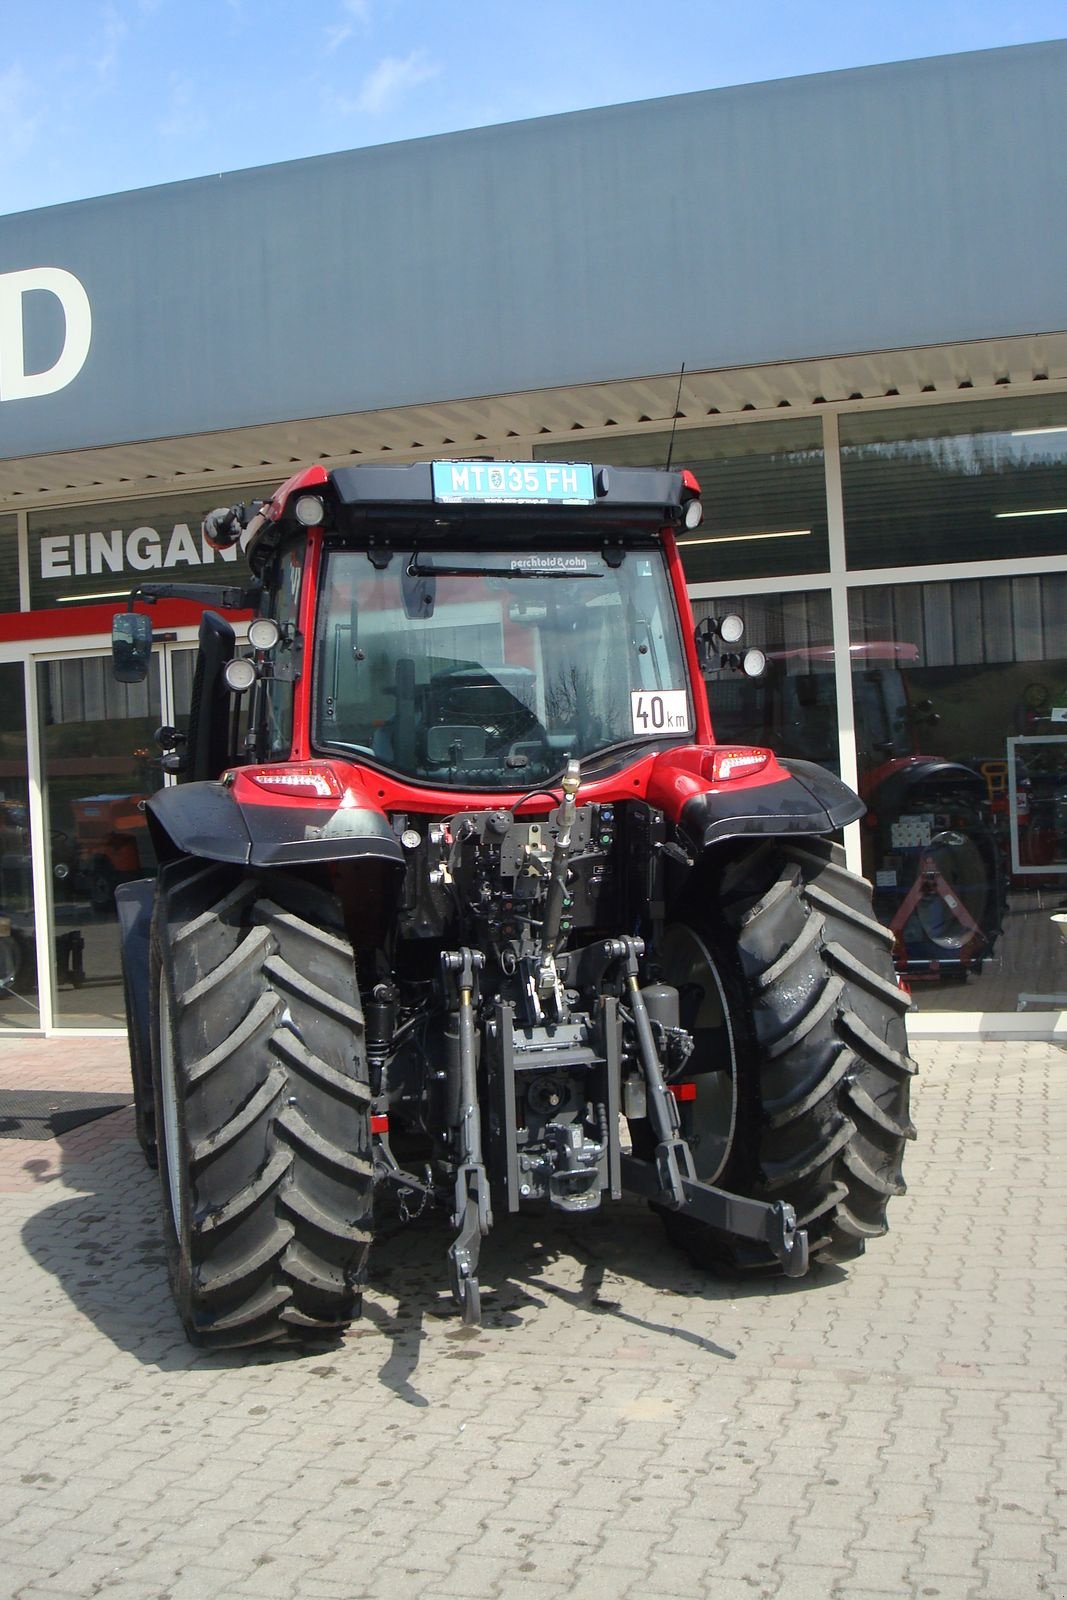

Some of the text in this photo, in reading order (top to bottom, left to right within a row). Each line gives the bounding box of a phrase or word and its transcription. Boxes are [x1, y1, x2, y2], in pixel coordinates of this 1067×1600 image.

[0, 267, 92, 401] D
[451, 467, 577, 493] MT 35 FH
[40, 521, 252, 579] EINGA
[636, 696, 685, 729] 40 km
